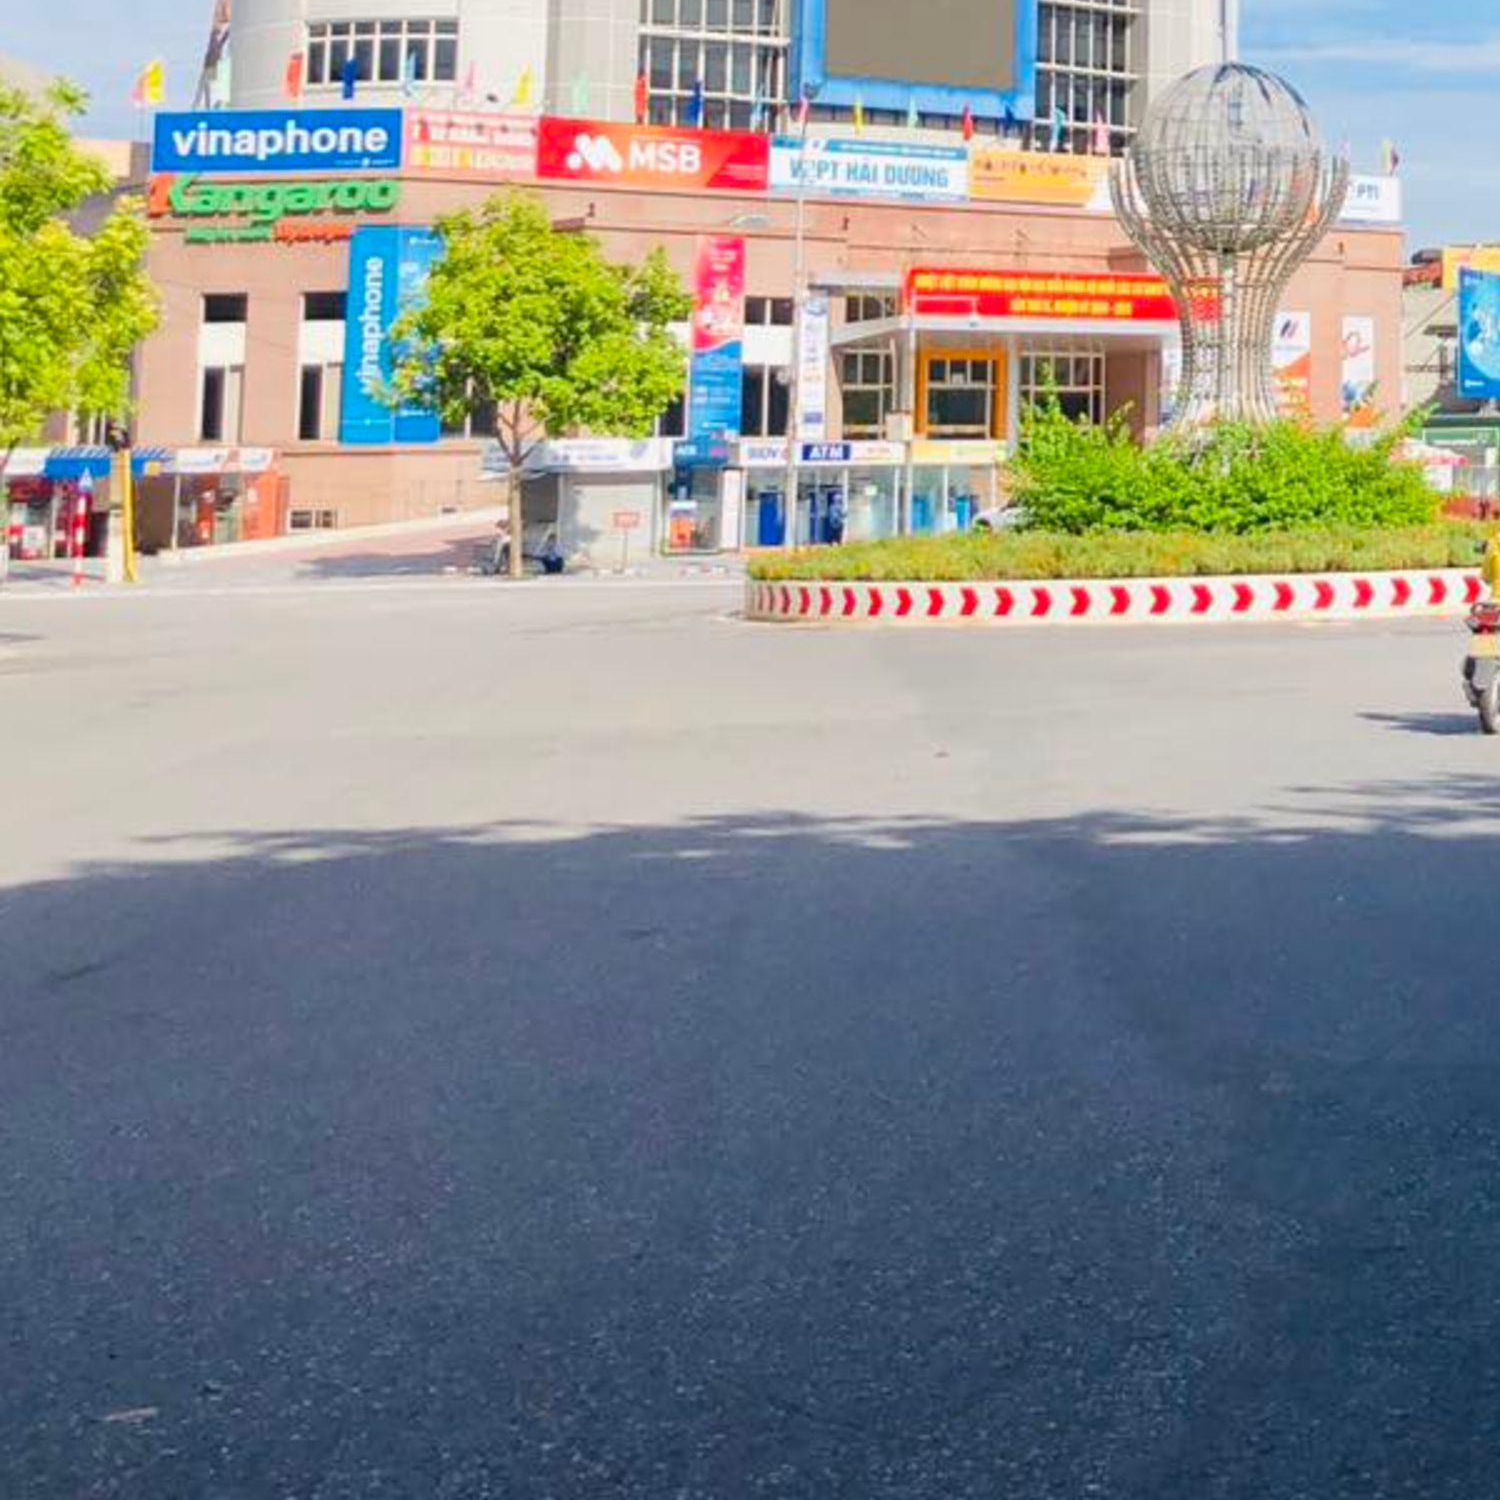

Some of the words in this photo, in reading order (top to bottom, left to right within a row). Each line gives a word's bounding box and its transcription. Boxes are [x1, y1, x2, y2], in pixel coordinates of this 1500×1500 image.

[172, 120, 388, 161] vinaphone
[628, 140, 702, 174] MSB
[790, 158, 838, 181] VPT
[148, 172, 402, 225] Kangaroo
[808, 445, 844, 460] ATM
